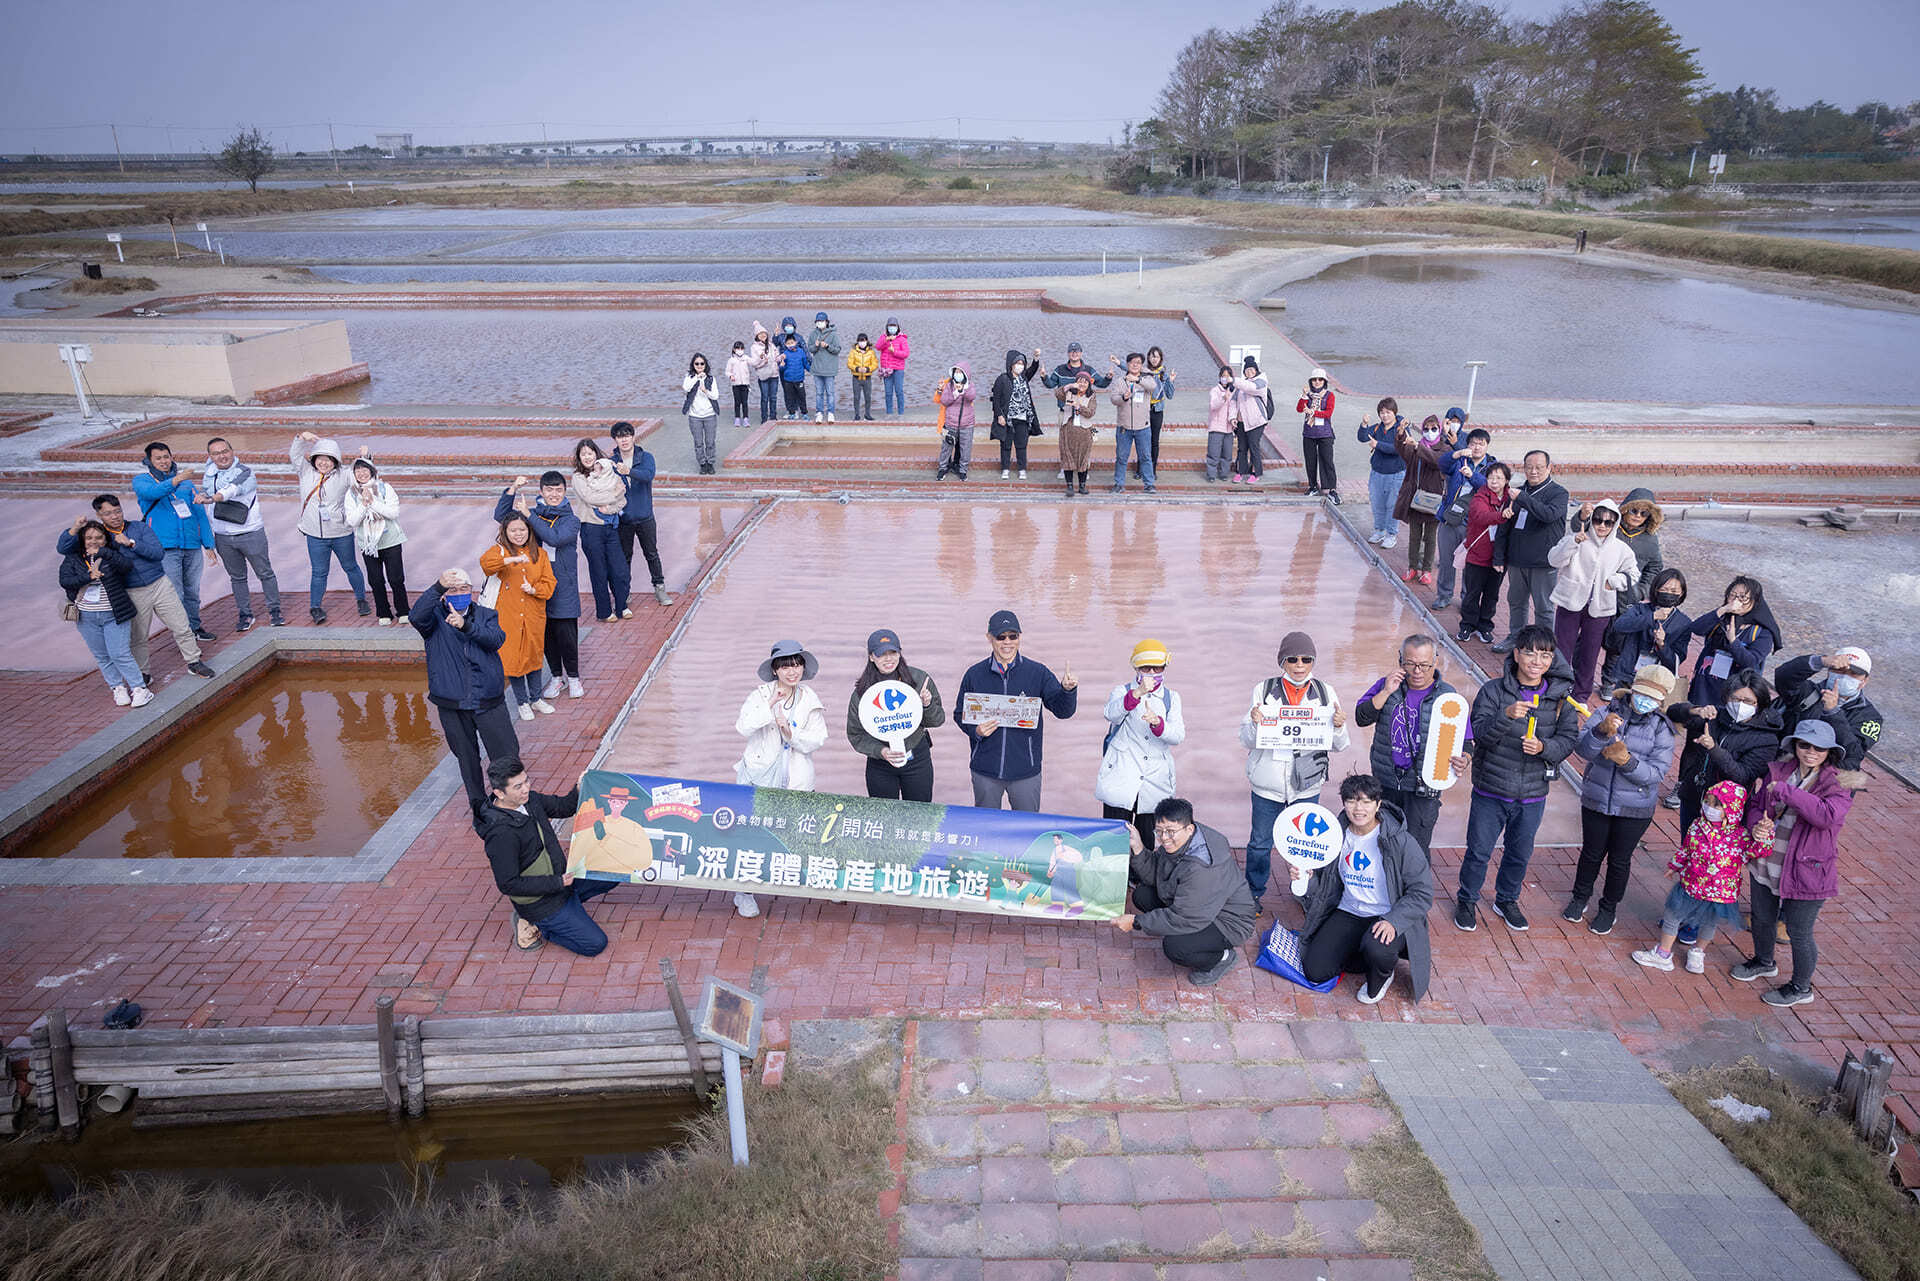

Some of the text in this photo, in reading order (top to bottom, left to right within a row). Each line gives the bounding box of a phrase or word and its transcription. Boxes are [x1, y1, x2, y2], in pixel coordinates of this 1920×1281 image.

[873, 711, 912, 724] Carrefour
[1282, 725, 1302, 737] 89
[1286, 835, 1329, 851] Carrefour
